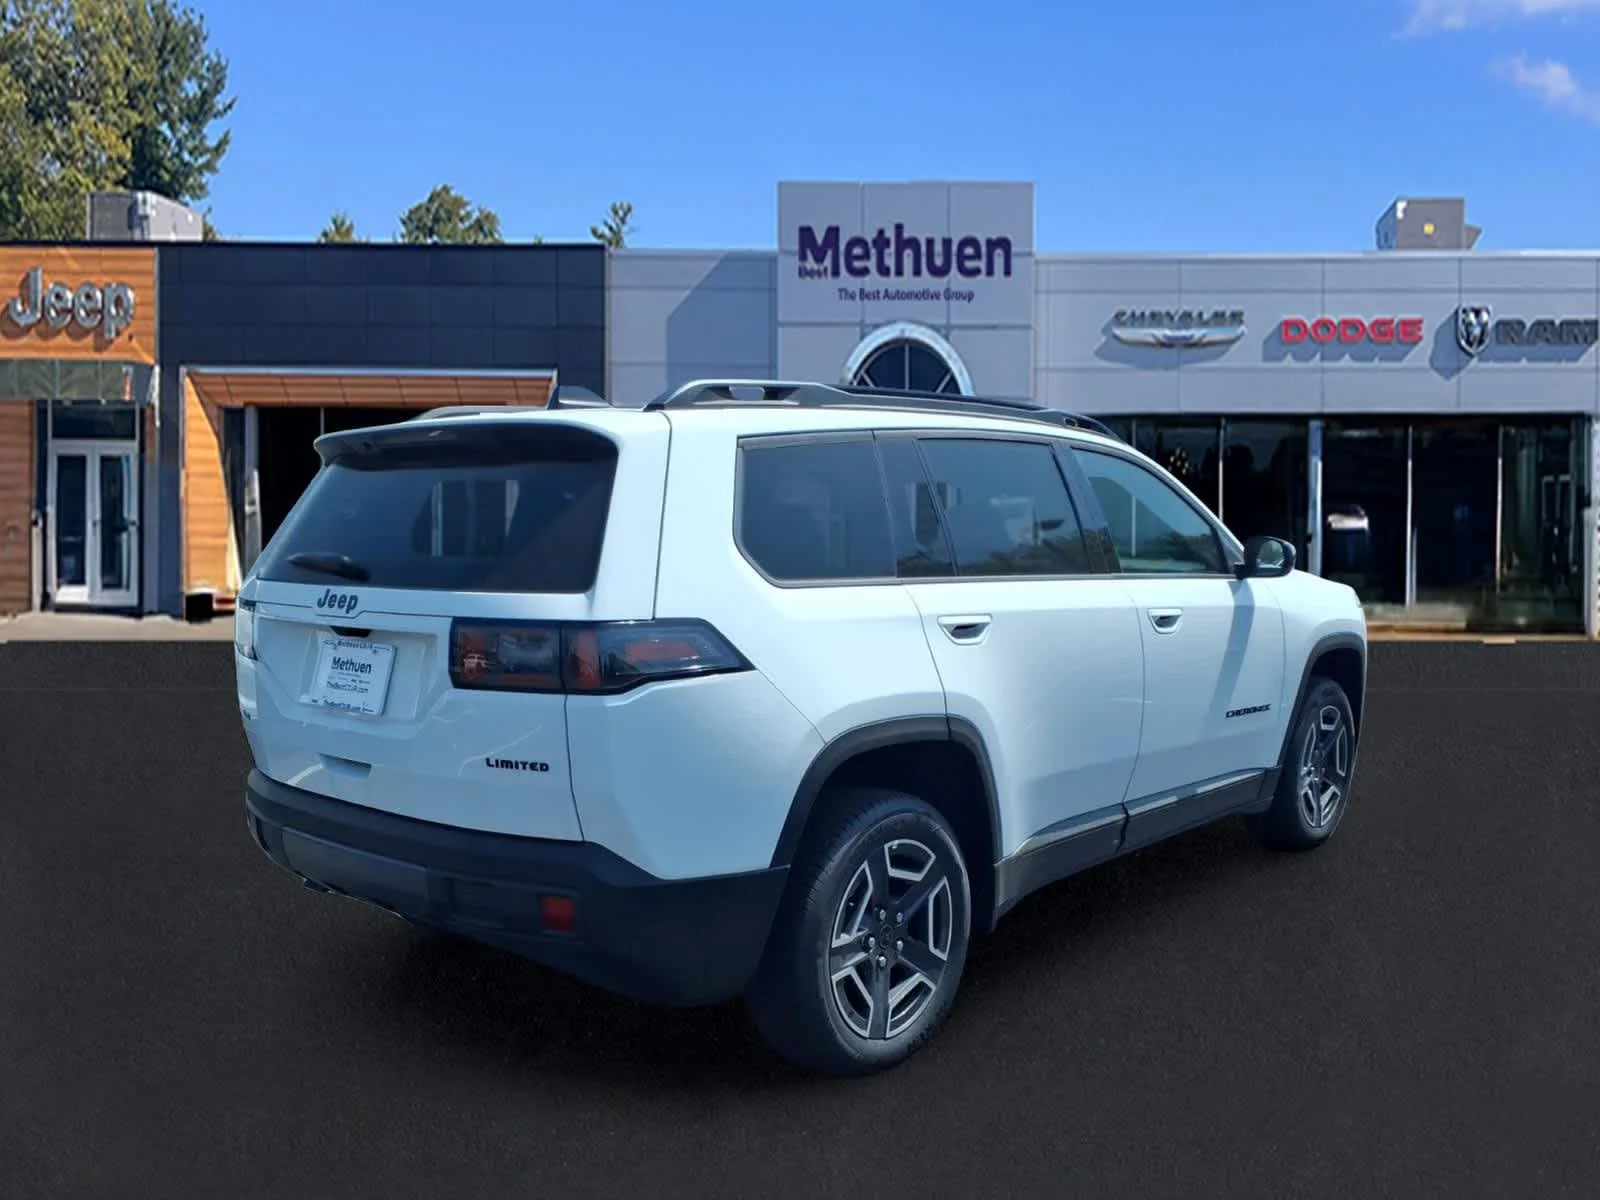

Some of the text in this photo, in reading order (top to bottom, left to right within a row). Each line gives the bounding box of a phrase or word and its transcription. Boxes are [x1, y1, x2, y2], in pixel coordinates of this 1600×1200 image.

[798, 223, 1012, 277] Methuen
[8, 266, 135, 340] Jeep
[838, 288, 975, 303] The Best Automotive Group
[1282, 317, 1424, 344] DODGE
[1495, 319, 1599, 345] RAM
[317, 588, 359, 614] Jeep
[331, 657, 372, 674] Methuen
[485, 757, 550, 772] LIMITED
